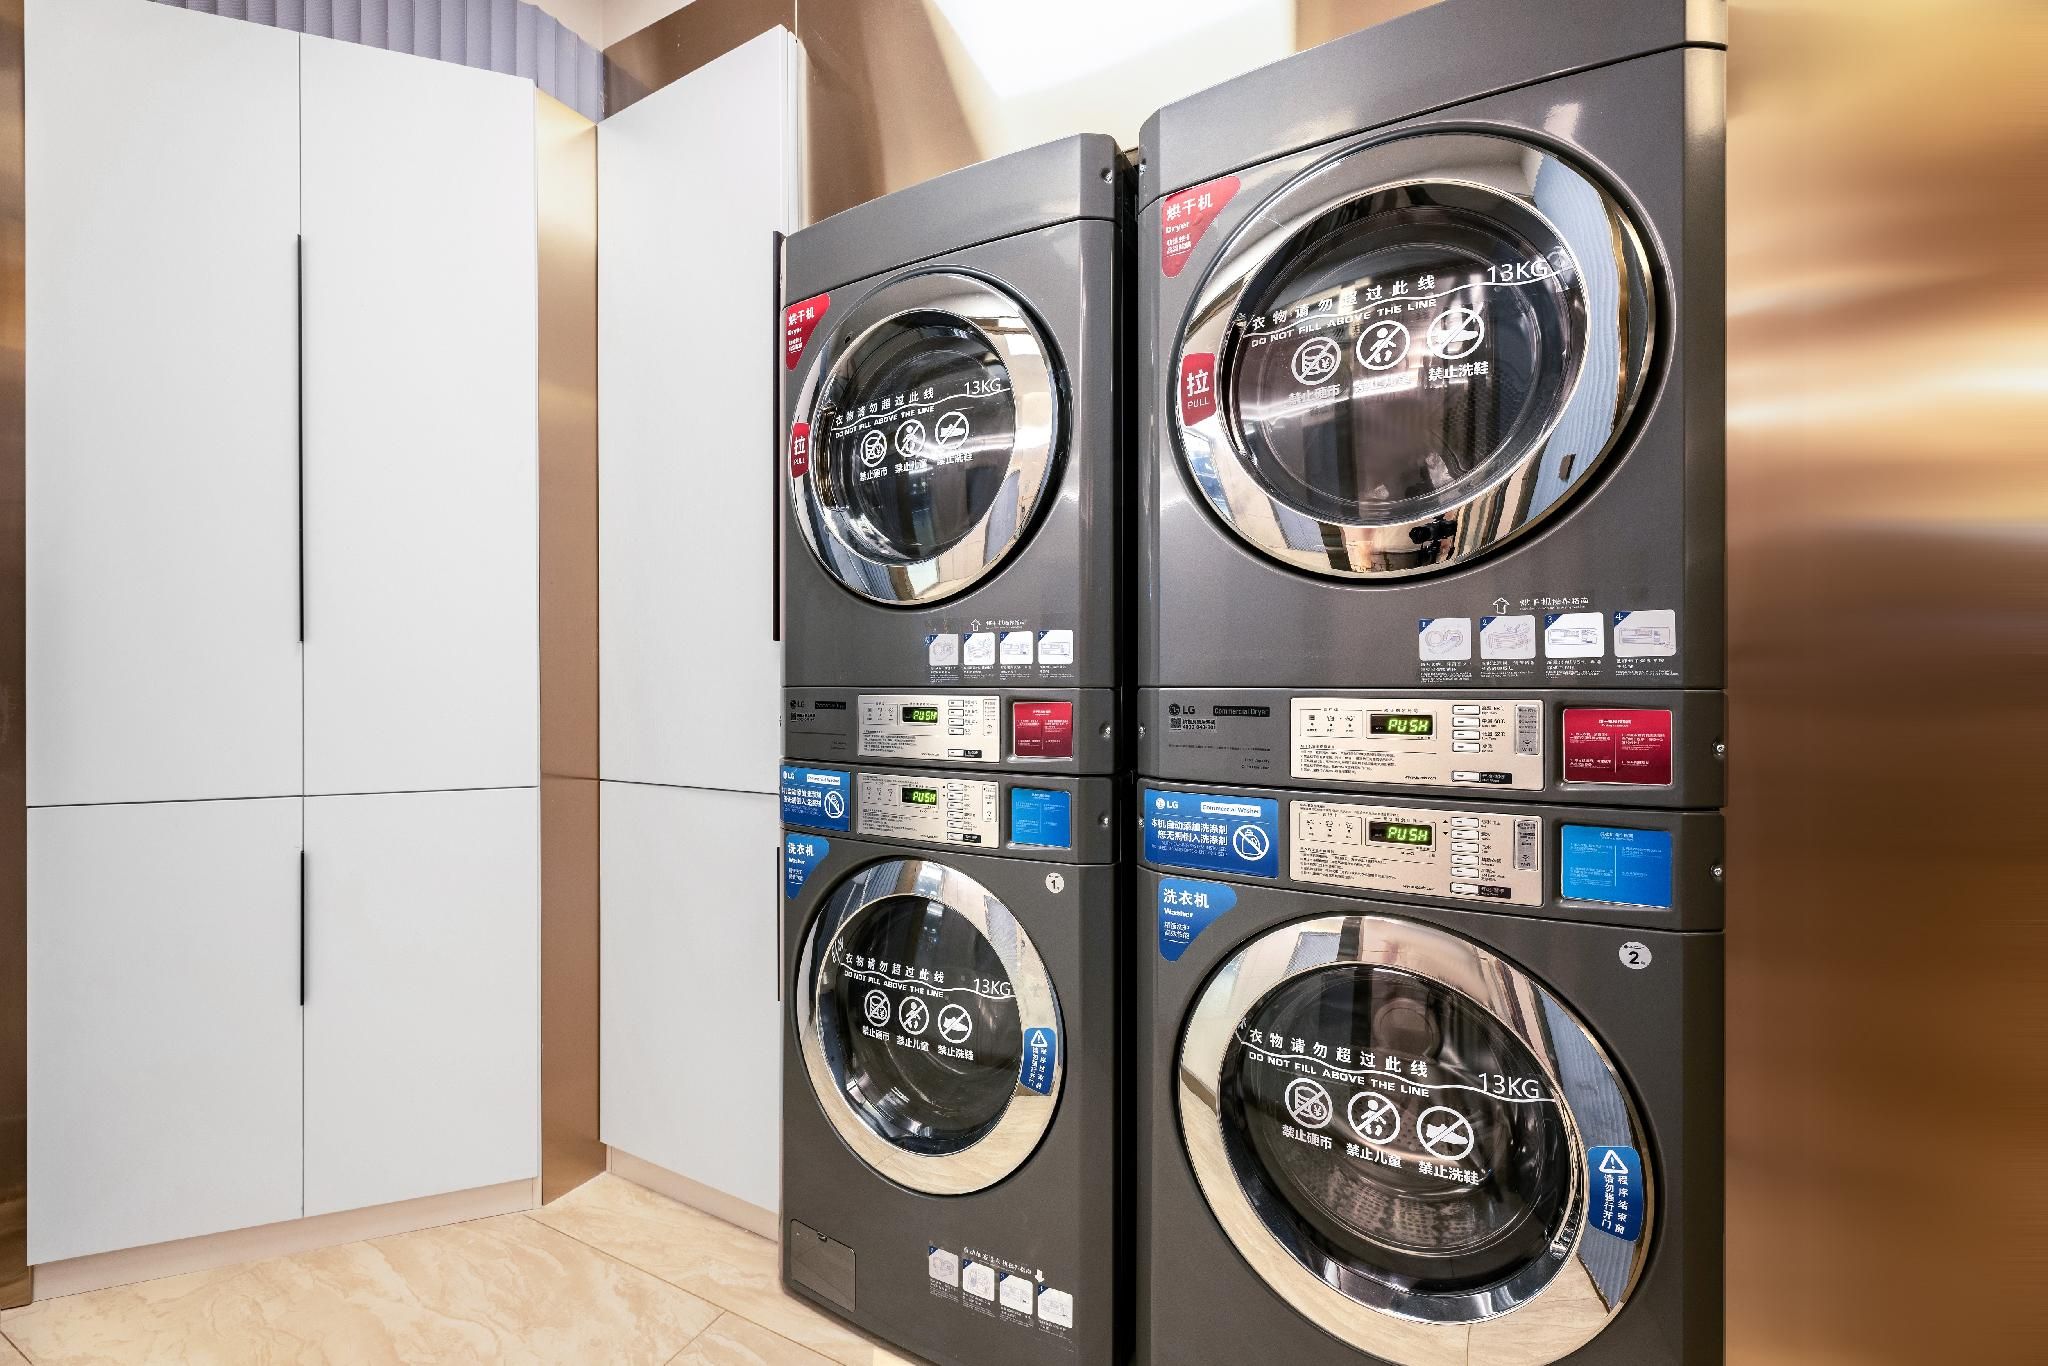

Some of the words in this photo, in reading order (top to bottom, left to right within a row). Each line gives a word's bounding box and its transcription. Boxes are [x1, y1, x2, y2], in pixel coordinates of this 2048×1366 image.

[1166, 192, 1213, 221] 烘干机
[1166, 222, 1189, 233] Dryer
[1487, 261, 1548, 283] 13KG
[788, 307, 815, 327] 烘干机
[1252, 337, 1266, 348] DO
[1270, 329, 1294, 343] NOT
[1299, 323, 1321, 335] FILL
[1327, 312, 1371, 328] ABOVE
[1376, 305, 1402, 317] THE
[1408, 298, 1437, 311] LINE
[1428, 361, 1489, 381] 禁止洗鞋
[964, 377, 1001, 396] 13KG
[1186, 369, 1210, 397] 拉
[1187, 397, 1209, 409] PULL
[844, 426, 857, 435] NOT
[874, 414, 898, 425] ABOVE
[901, 409, 916, 418] THE
[917, 405, 935, 415] LINE
[794, 435, 806, 456] 拉
[912, 710, 937, 721] PUSH
[1182, 705, 1195, 715] LG
[1388, 719, 1429, 733] PUSH
[912, 791, 937, 803] PUSH
[1166, 800, 1179, 809] LG
[1388, 826, 1428, 841] PUSH
[788, 842, 815, 857] 洗衣机
[1163, 887, 1210, 909] 洗衣机
[1163, 907, 1194, 918] Washer
[846, 953, 945, 984] 衣物请勿超过此线
[1628, 951, 1640, 965] 2
[853, 971, 867, 982] NOT
[883, 980, 907, 991] ABOVE
[910, 985, 925, 995] THE
[926, 988, 944, 999] LINE
[973, 977, 1011, 996] 13KG
[1250, 1028, 1428, 1078] 衣物请勿超过此线
[1249, 1051, 1264, 1062] DO
[1268, 1056, 1291, 1068] NOT
[1294, 1063, 1317, 1075] FILL
[1322, 1068, 1365, 1085] ABOVE
[1371, 1079, 1396, 1091] THE
[1400, 1084, 1430, 1098] LINE
[1478, 1072, 1540, 1099] 13KG
[1281, 1124, 1333, 1150] 禁止硬币
[1346, 1142, 1403, 1169] 禁止儿童
[1418, 1160, 1480, 1186] 禁止洗鞋
[1601, 1174, 1615, 1230] 请勿强行开门
[1614, 1175, 1629, 1235] 程序结束前
